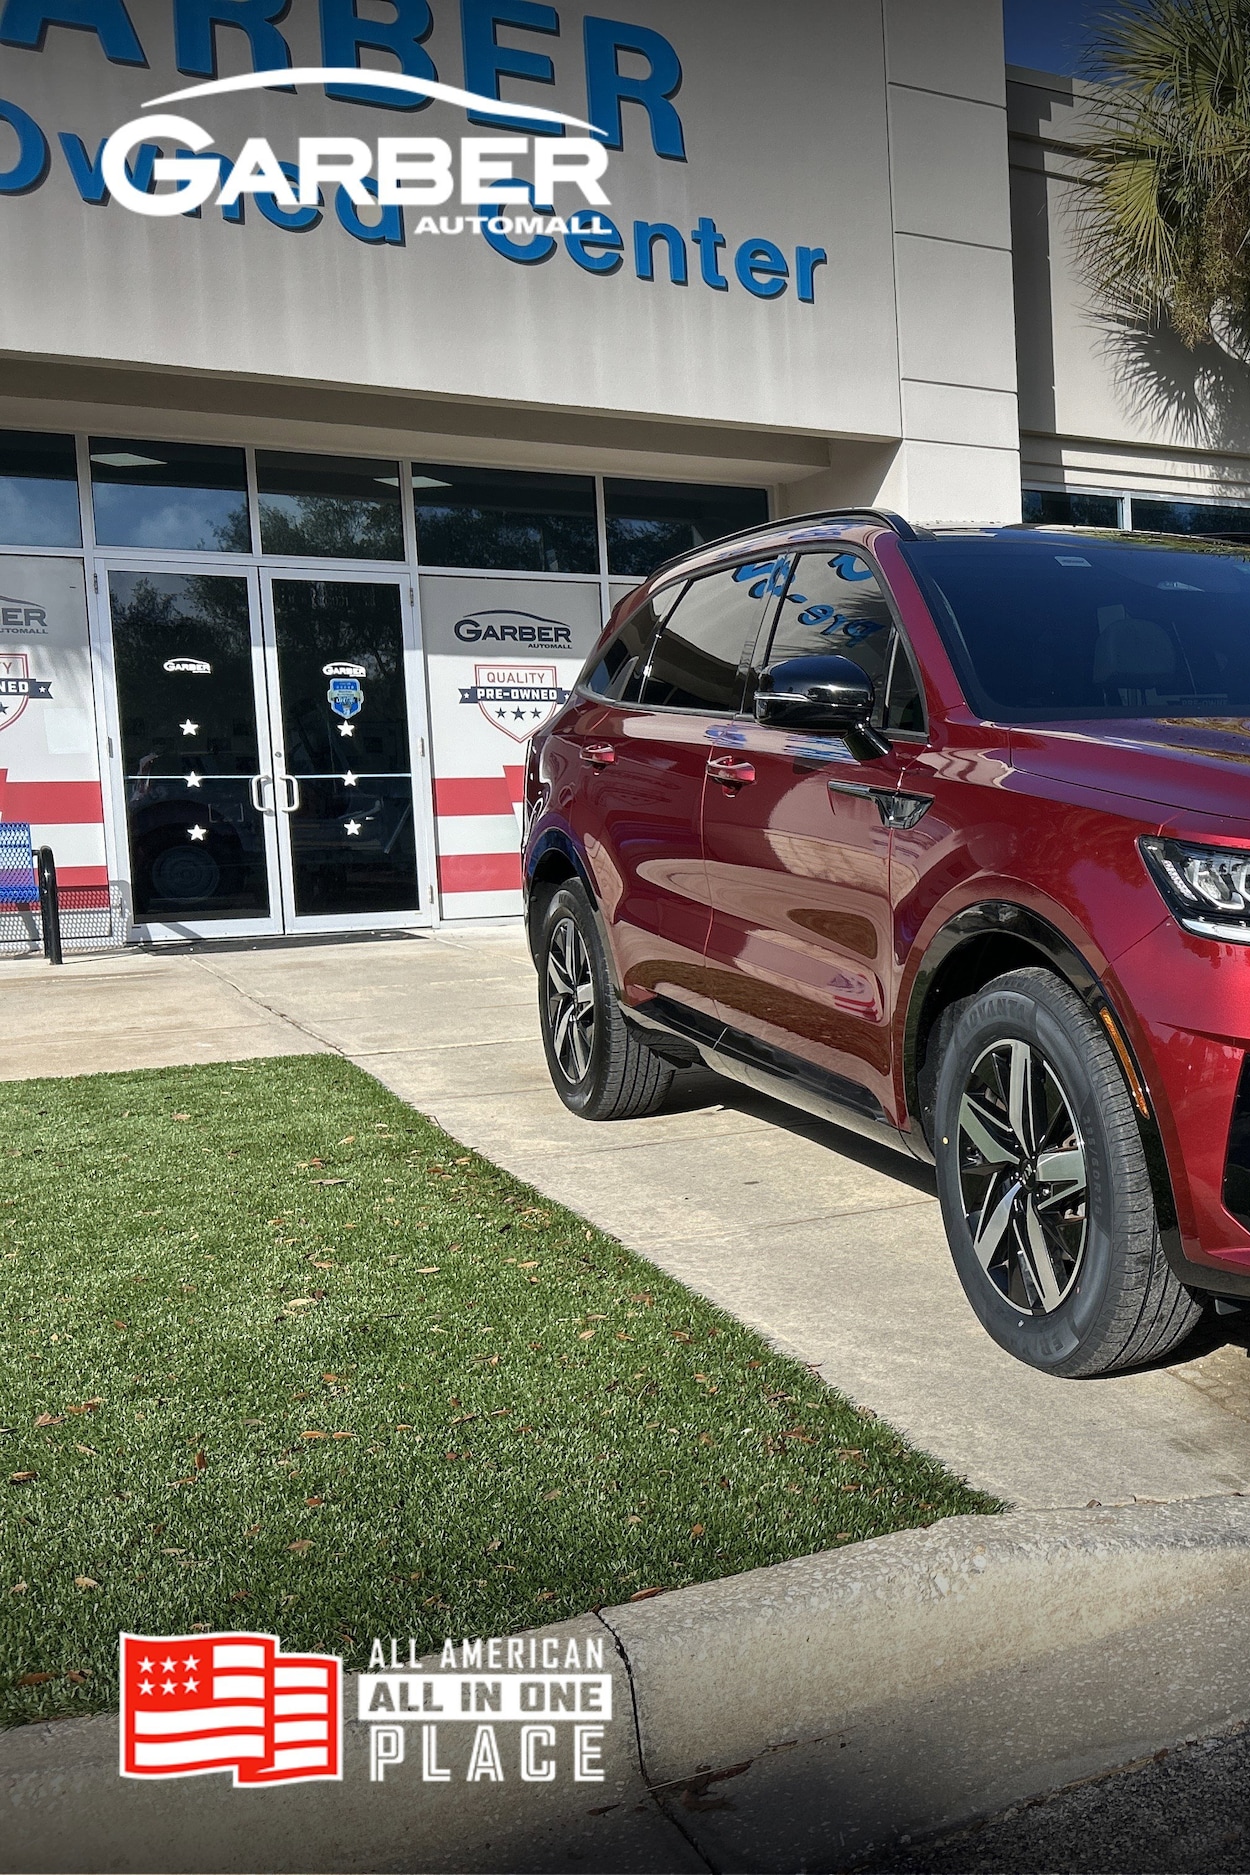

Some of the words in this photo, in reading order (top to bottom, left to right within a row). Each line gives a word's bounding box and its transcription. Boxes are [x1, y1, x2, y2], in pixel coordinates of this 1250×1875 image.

[478, 178, 828, 304] Center
[454, 619, 572, 643] GARBER
[487, 672, 545, 684] QUALITY
[477, 688, 558, 700] PRE-OWNED
